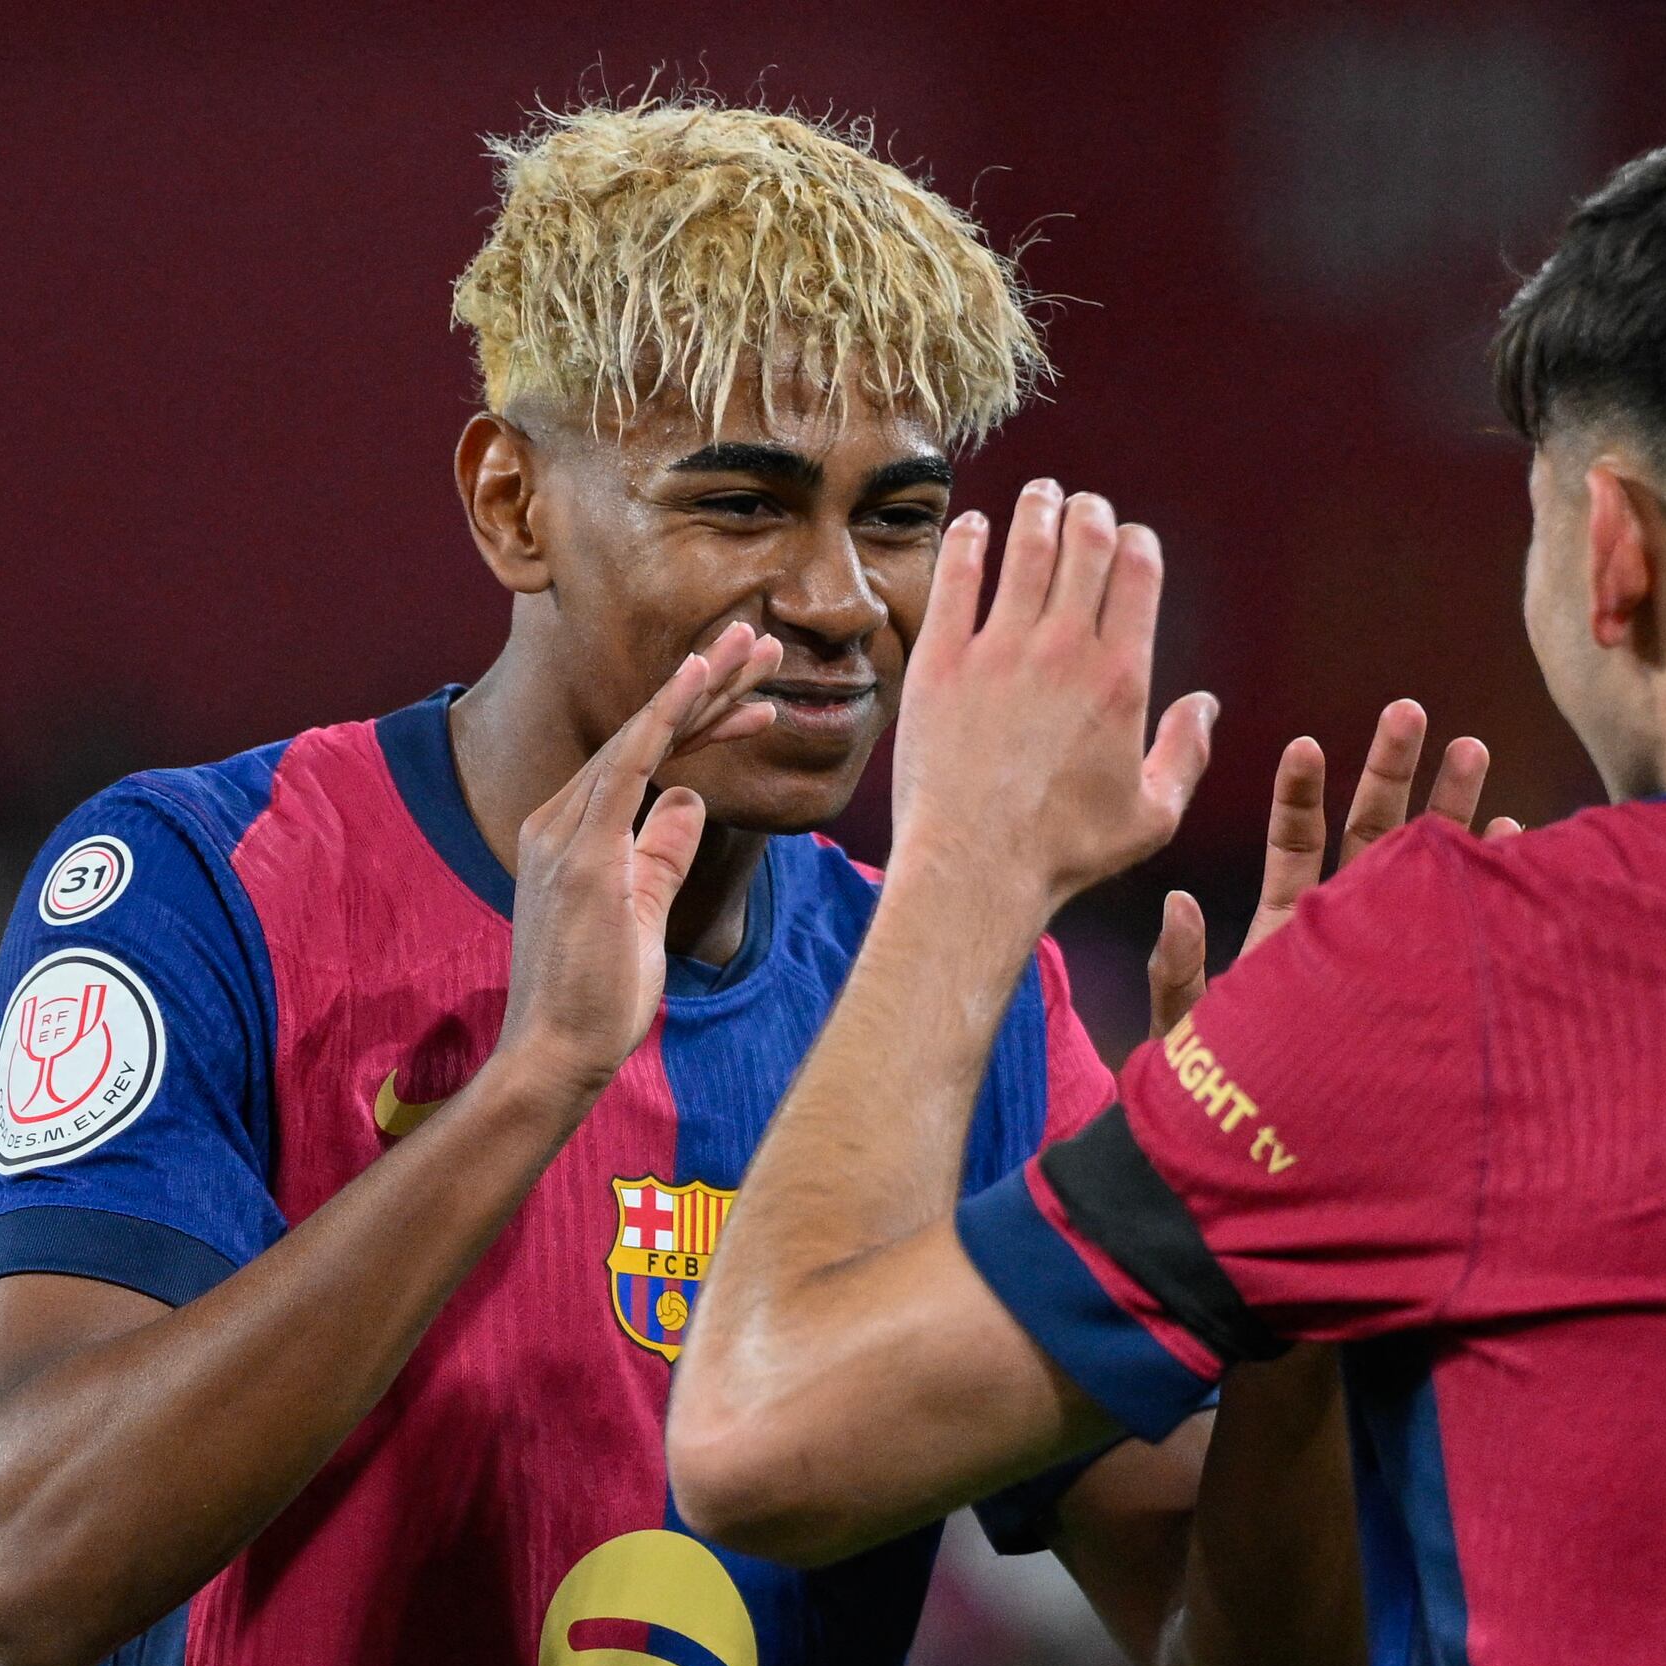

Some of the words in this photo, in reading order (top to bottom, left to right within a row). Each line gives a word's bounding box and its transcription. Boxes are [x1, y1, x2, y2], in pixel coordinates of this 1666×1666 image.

[59, 865, 108, 894] 31
[41, 1010, 70, 1027] RF
[38, 1027, 67, 1043] EF
[7, 1134, 23, 1149] DE
[73, 1108, 106, 1131] EL
[103, 1060, 137, 1105] REY
